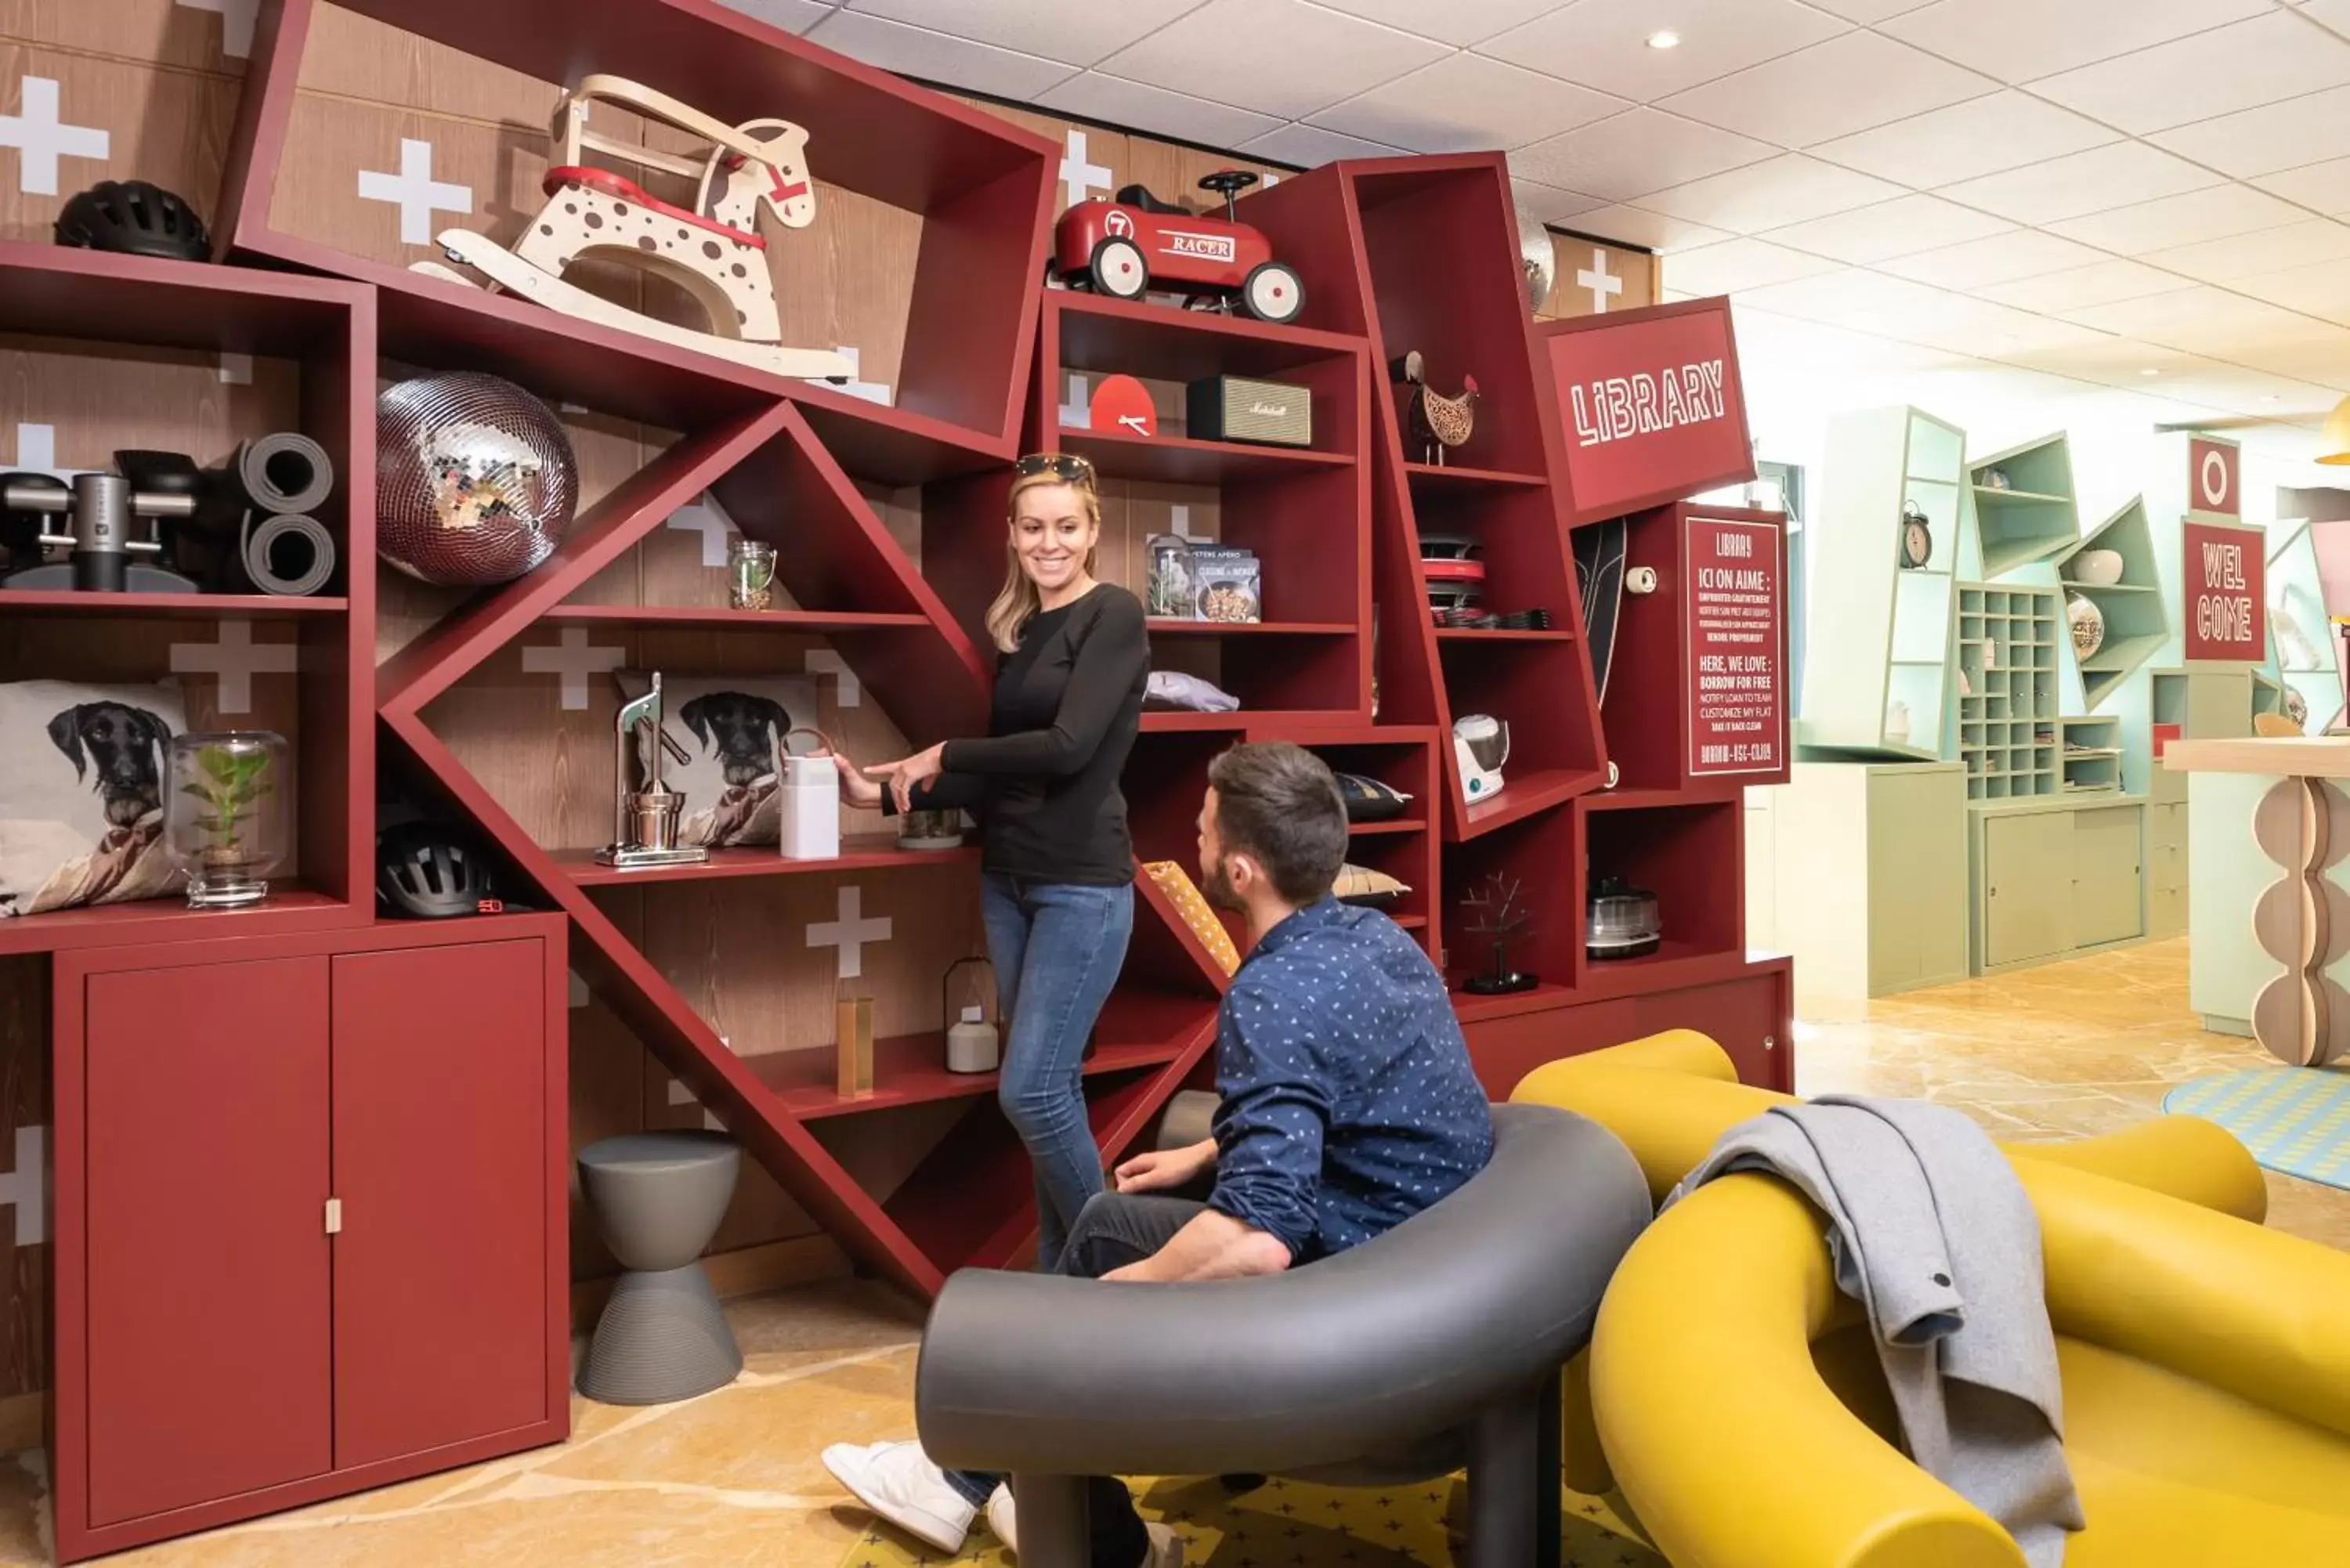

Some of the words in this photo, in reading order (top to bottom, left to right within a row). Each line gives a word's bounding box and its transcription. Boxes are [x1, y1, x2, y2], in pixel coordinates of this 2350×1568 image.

[1110, 216, 1126, 236] 7
[1173, 237, 1229, 256] RACER
[2202, 542, 2246, 589] WEL
[1698, 568, 1713, 588] ICI
[1716, 569, 1733, 589] ON
[1735, 570, 1765, 591] AIME
[2197, 594, 2252, 641] COME
[1699, 656, 1728, 674] HERE,
[1728, 656, 1744, 672] WE
[1744, 656, 1766, 672] LOVE
[1700, 676, 1735, 690] BORROW
[1737, 676, 1752, 689] FOR
[1753, 676, 1771, 688] FREE
[1725, 693, 1744, 703] LOAN
[1744, 693, 1754, 703] TO
[1754, 693, 1772, 703] TEAM
[1700, 707, 1742, 719] CUSTOMIZE
[1743, 707, 1755, 717] MY
[1755, 706, 1772, 717] FLAT
